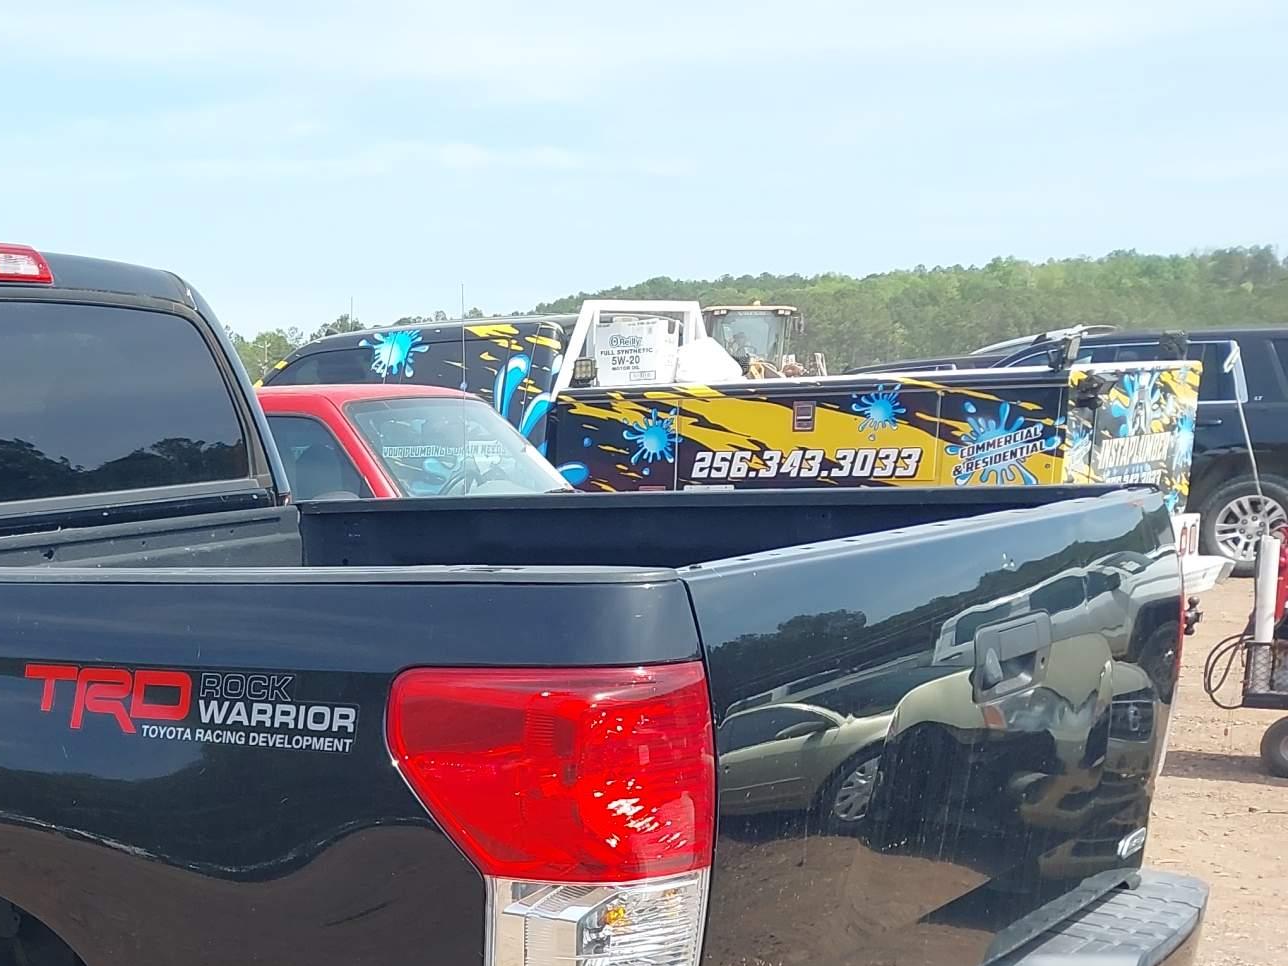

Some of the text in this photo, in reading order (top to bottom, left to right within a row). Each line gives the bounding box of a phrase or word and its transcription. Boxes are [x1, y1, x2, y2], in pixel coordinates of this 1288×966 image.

[611, 355, 641, 366] 5W-20
[616, 347, 653, 356] SYNTHETIC
[953, 438, 1046, 476] & RESIDENTIAL
[959, 426, 1041, 458] COMMERCIAL
[691, 448, 922, 478] 256.343.3033
[24, 663, 295, 734] TRD ROCK
[198, 699, 357, 733] WARRIOR
[141, 724, 353, 753] TOYOTA RACING DEVELOPMENT
